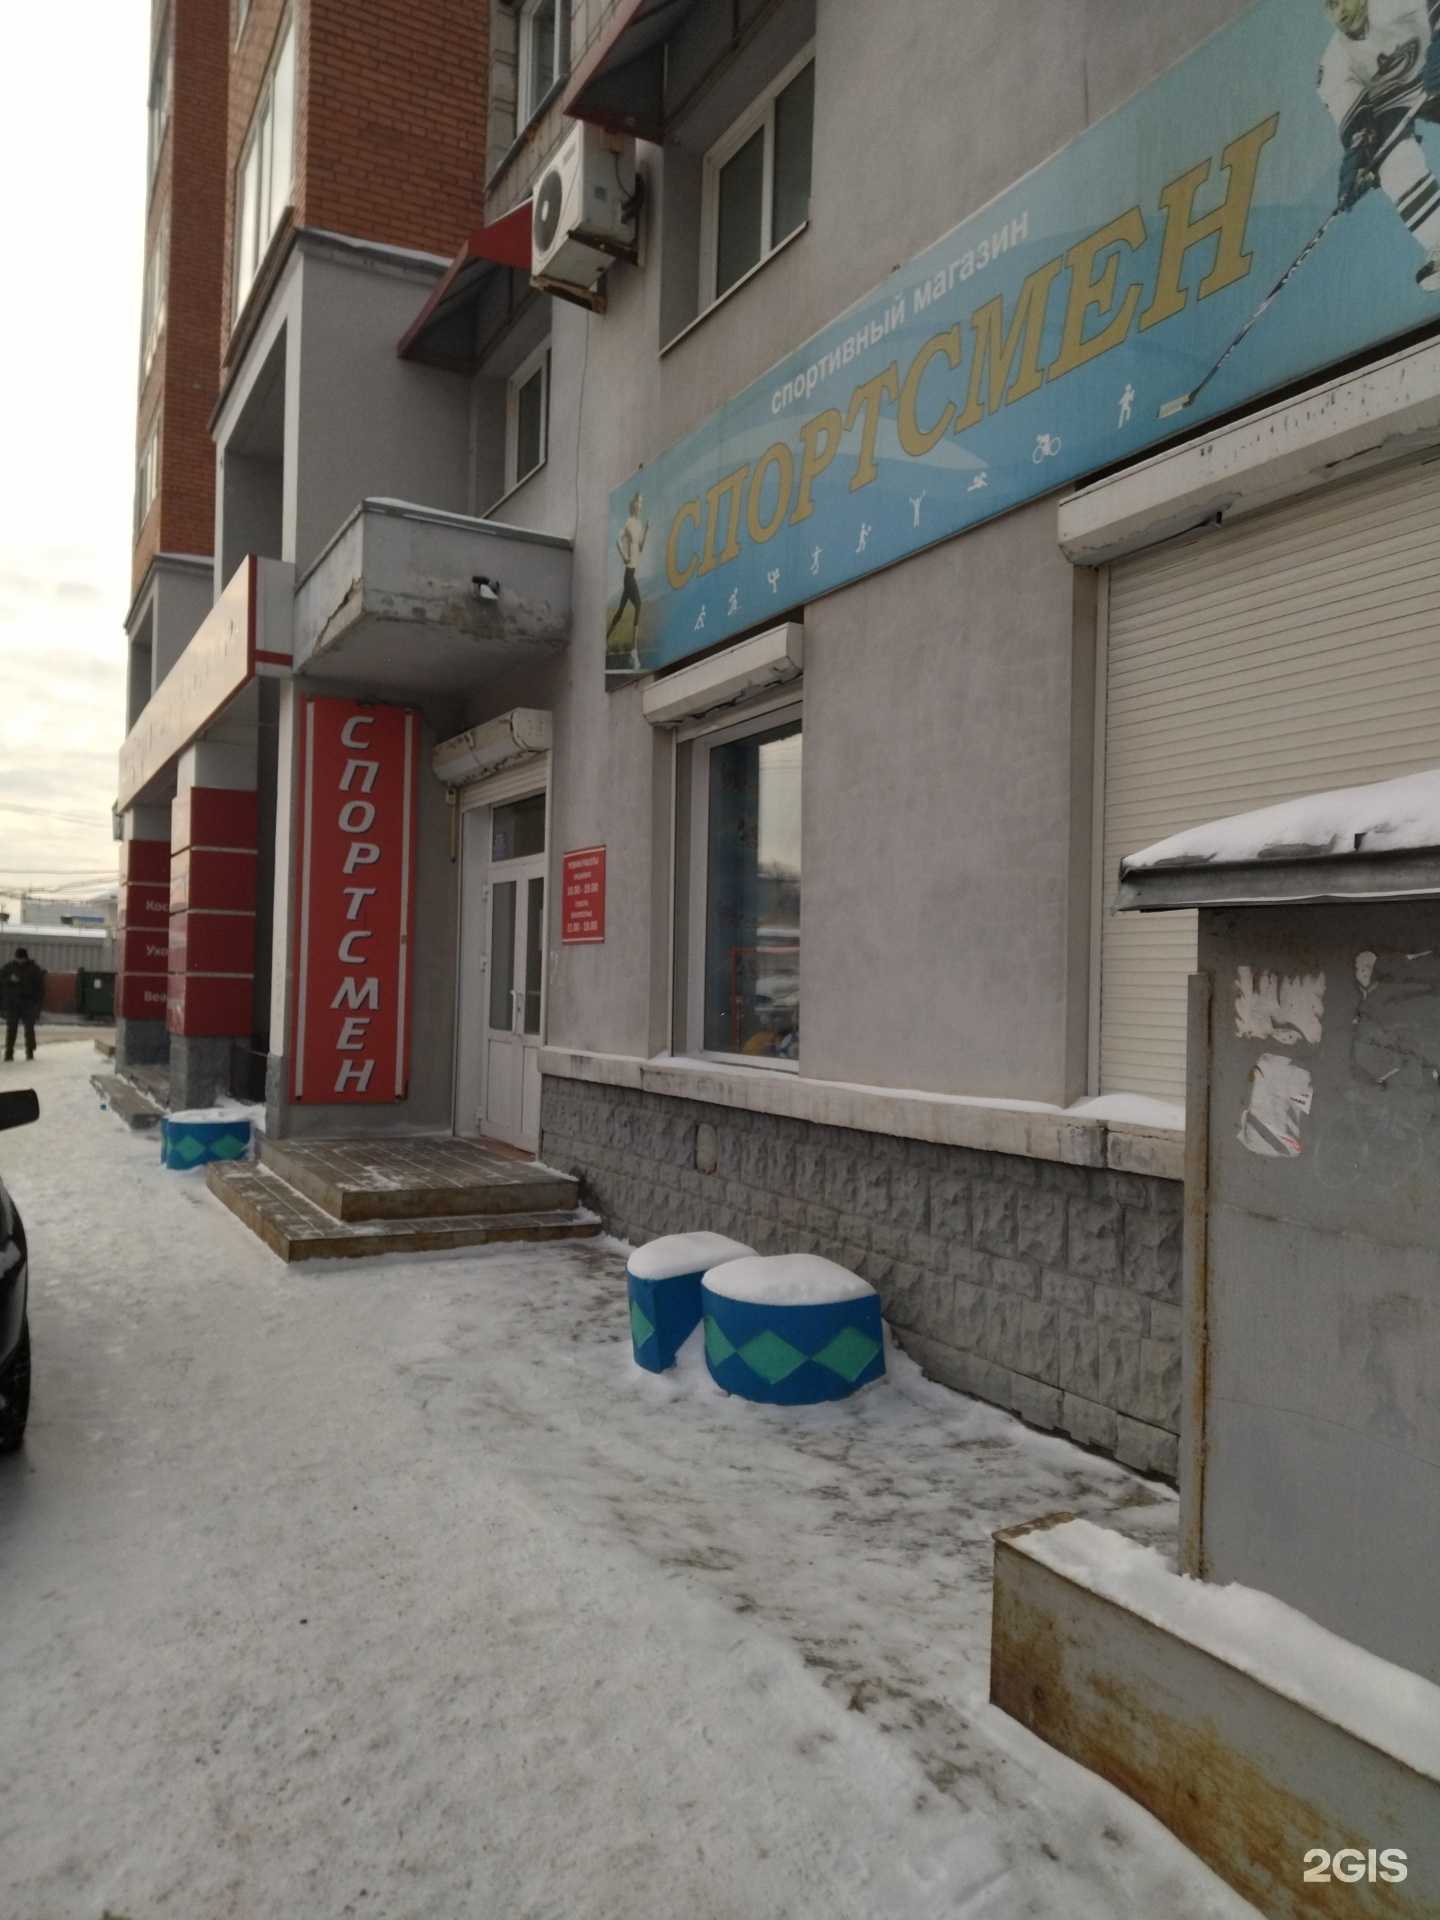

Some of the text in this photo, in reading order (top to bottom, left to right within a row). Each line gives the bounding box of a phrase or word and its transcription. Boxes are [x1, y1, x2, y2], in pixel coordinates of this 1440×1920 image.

[666, 111, 1280, 591] СПОРТСМЕН
[771, 211, 1029, 414] спортивный магазин
[330, 715, 381, 1093] СПОРТСМЕН
